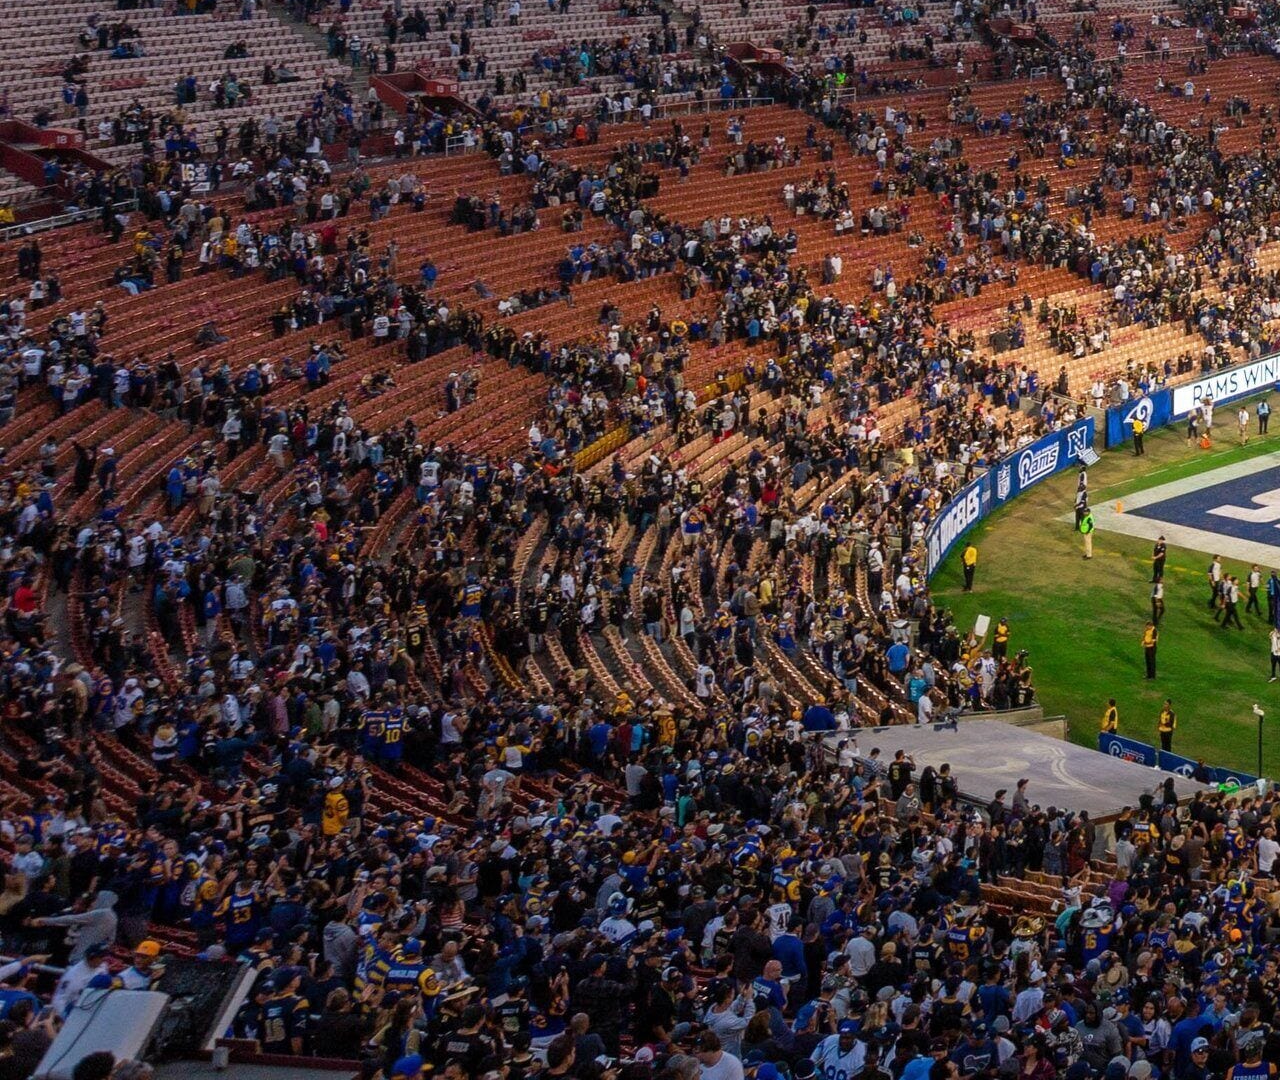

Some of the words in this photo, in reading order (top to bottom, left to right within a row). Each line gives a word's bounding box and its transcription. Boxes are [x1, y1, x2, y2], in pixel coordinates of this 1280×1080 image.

[1193, 376, 1238, 405] RAMS
[1244, 359, 1279, 386] WIN!
[1019, 446, 1059, 489] Rams
